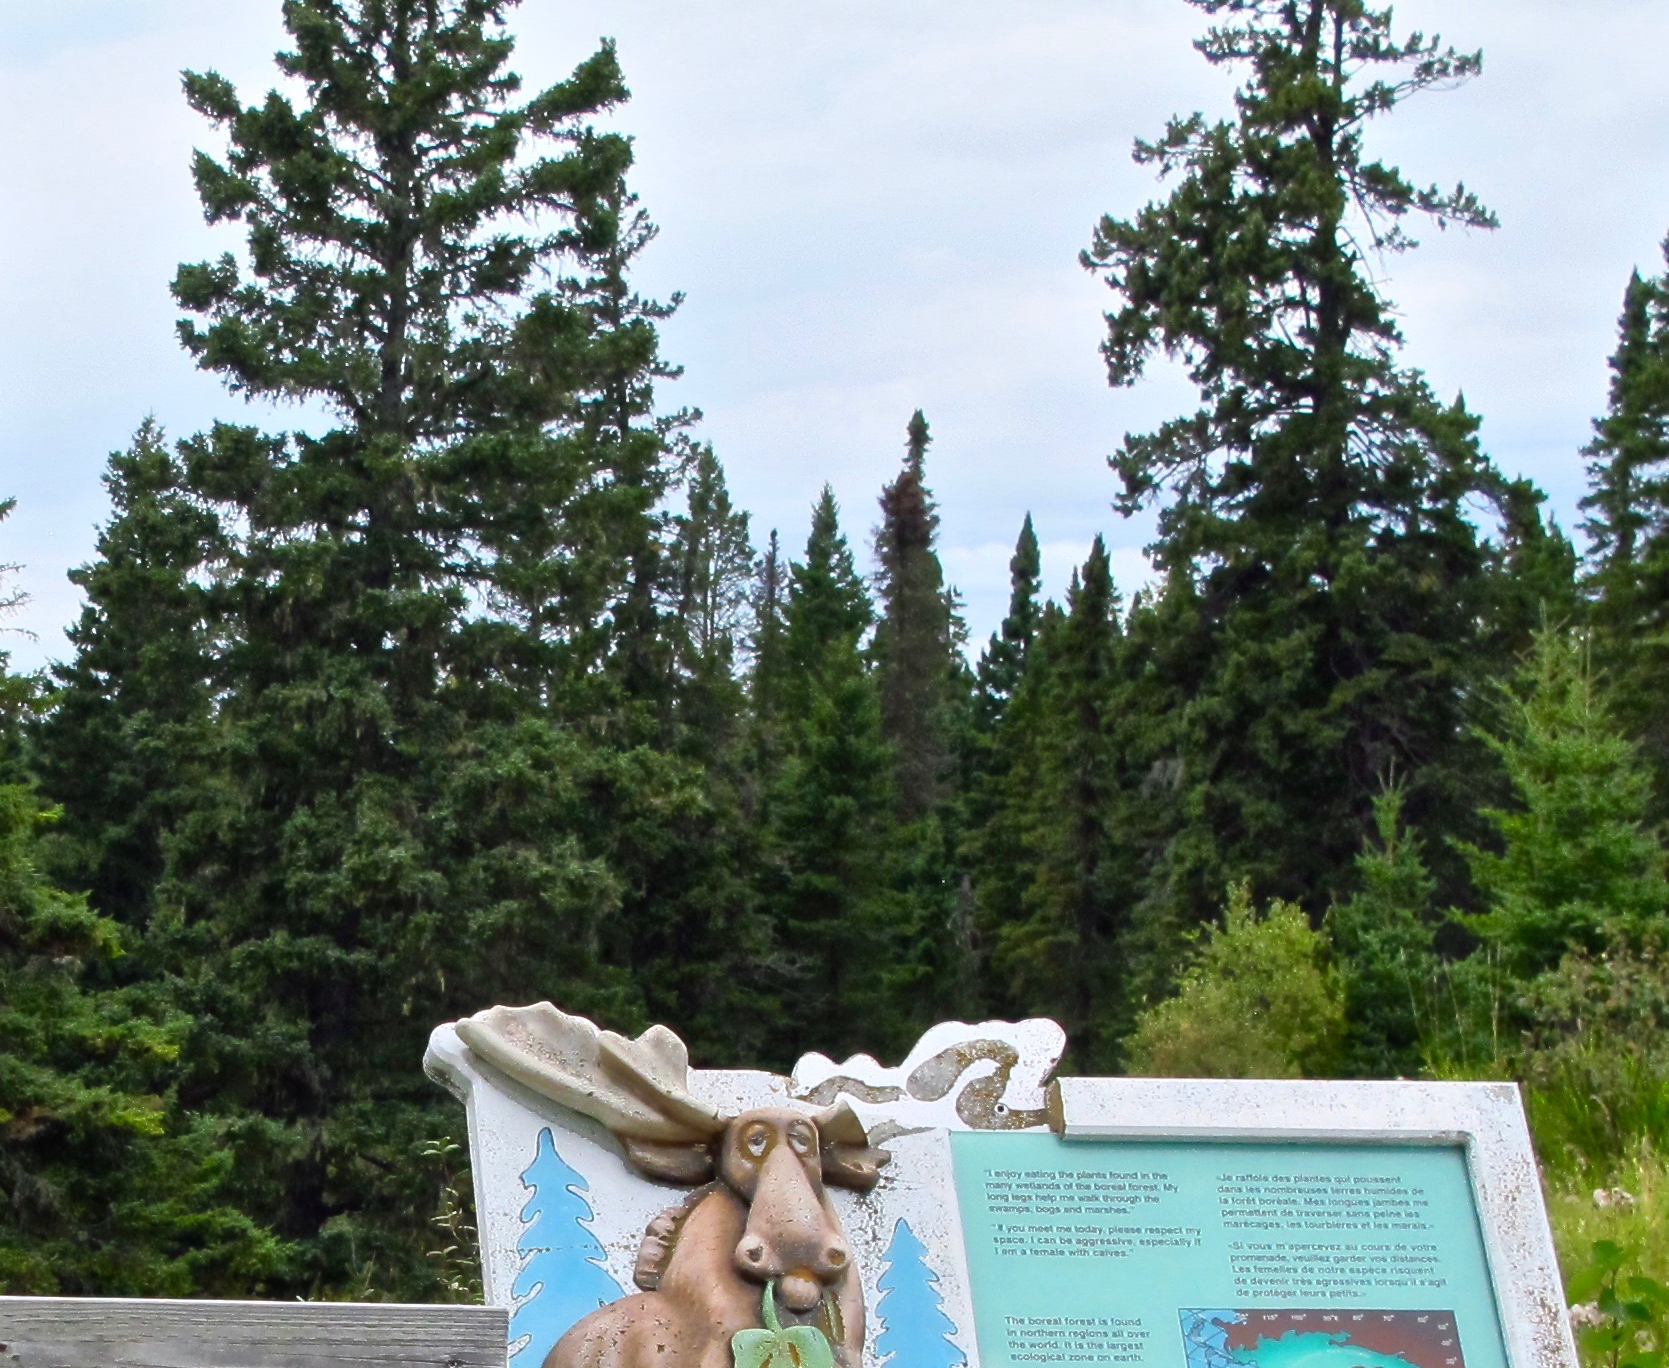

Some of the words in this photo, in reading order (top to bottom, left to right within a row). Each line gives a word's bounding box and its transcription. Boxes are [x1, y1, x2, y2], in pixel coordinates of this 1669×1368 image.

[994, 1170, 1022, 1180] enjoy
[1024, 1170, 1057, 1180] eating
[1058, 1171, 1075, 1179] the
[1076, 1171, 1107, 1181] plants
[1109, 1171, 1139, 1179] found
[1140, 1171, 1150, 1179] in
[1151, 1172, 1169, 1180] the
[1235, 1174, 1269, 1182] raffole
[1271, 1174, 1291, 1182] des
[1293, 1175, 1332, 1185] plantes
[1334, 1175, 1350, 1185] qui
[1353, 1175, 1402, 1185] poussent
[985, 1183, 1013, 1191] many
[1015, 1182, 1061, 1190] wetlands
[1063, 1182, 1074, 1190] of
[1075, 1182, 1092, 1190] the
[1093, 1182, 1127, 1190] boreal
[1163, 1183, 1179, 1193] My
[1217, 1185, 1243, 1193] dans
[1245, 1186, 1262, 1194] les
[1263, 1186, 1329, 1194] nombreuses
[1330, 1187, 1362, 1195] terres
[1363, 1187, 1409, 1195] humides
[1411, 1187, 1424, 1195] de
[987, 1193, 1010, 1203] long
[1011, 1193, 1033, 1203] legs
[1034, 1193, 1057, 1203] help
[1077, 1194, 1100, 1202] walk
[1102, 1194, 1142, 1204] through
[1143, 1194, 1160, 1202] the
[1218, 1197, 1229, 1205] la
[1231, 1197, 1256, 1205] forêt
[1303, 1198, 1325, 1206] Mes
[1328, 1198, 1370, 1208] longues
[1372, 1198, 1410, 1208] jambes
[1035, 1205, 1061, 1215] bogs
[1063, 1205, 1083, 1213] and
[1221, 1208, 1278, 1218] permettent
[1280, 1209, 1294, 1217] de
[1295, 1209, 1342, 1217] traverser
[1372, 1210, 1402, 1220] peine
[1404, 1210, 1420, 1218] les
[1006, 1226, 1025, 1234] you
[1027, 1224, 1054, 1232] meet
[1108, 1225, 1142, 1235] please
[1144, 1226, 1183, 1236] respect
[1185, 1228, 1202, 1236] my
[1286, 1221, 1302, 1229] les
[1304, 1221, 1358, 1229] tourbières
[1360, 1221, 1371, 1229] et
[1373, 1222, 1389, 1230] les
[1030, 1236, 1035, 1244] I
[1059, 1237, 1073, 1245] be
[1139, 1238, 1191, 1248] especially
[1394, 1243, 1407, 1251] de
[1411, 1243, 1437, 1251] votre
[994, 1248, 999, 1256] I
[1029, 1248, 1066, 1256] female
[1068, 1248, 1090, 1256] with
[1333, 1254, 1366, 1264] garder
[1231, 1265, 1251, 1273] Les
[1253, 1265, 1298, 1273] femelles
[1301, 1265, 1315, 1273] de
[1317, 1266, 1346, 1274] notre
[1390, 1266, 1435, 1276] risquent
[1234, 1276, 1248, 1284] de
[1250, 1277, 1289, 1285] devenir
[1315, 1277, 1372, 1287] agressives
[1236, 1288, 1250, 1296] de
[1252, 1289, 1297, 1298] protéger
[1299, 1289, 1327, 1297] leurs
[1005, 1316, 1025, 1325] The
[1028, 1316, 1062, 1325] boreal
[1064, 1317, 1096, 1326] forest
[1098, 1317, 1108, 1326] is
[1110, 1317, 1142, 1326] found
[1006, 1328, 1017, 1337] in
[1019, 1328, 1066, 1337] northern
[1068, 1329, 1109, 1340] regions
[1111, 1329, 1124, 1338] all
[1008, 1340, 1026, 1349] the
[1064, 1340, 1072, 1349] It
[1074, 1341, 1084, 1350] is
[1086, 1341, 1104, 1350] the
[1106, 1341, 1144, 1352] largest
[1010, 1352, 1066, 1363] ecological
